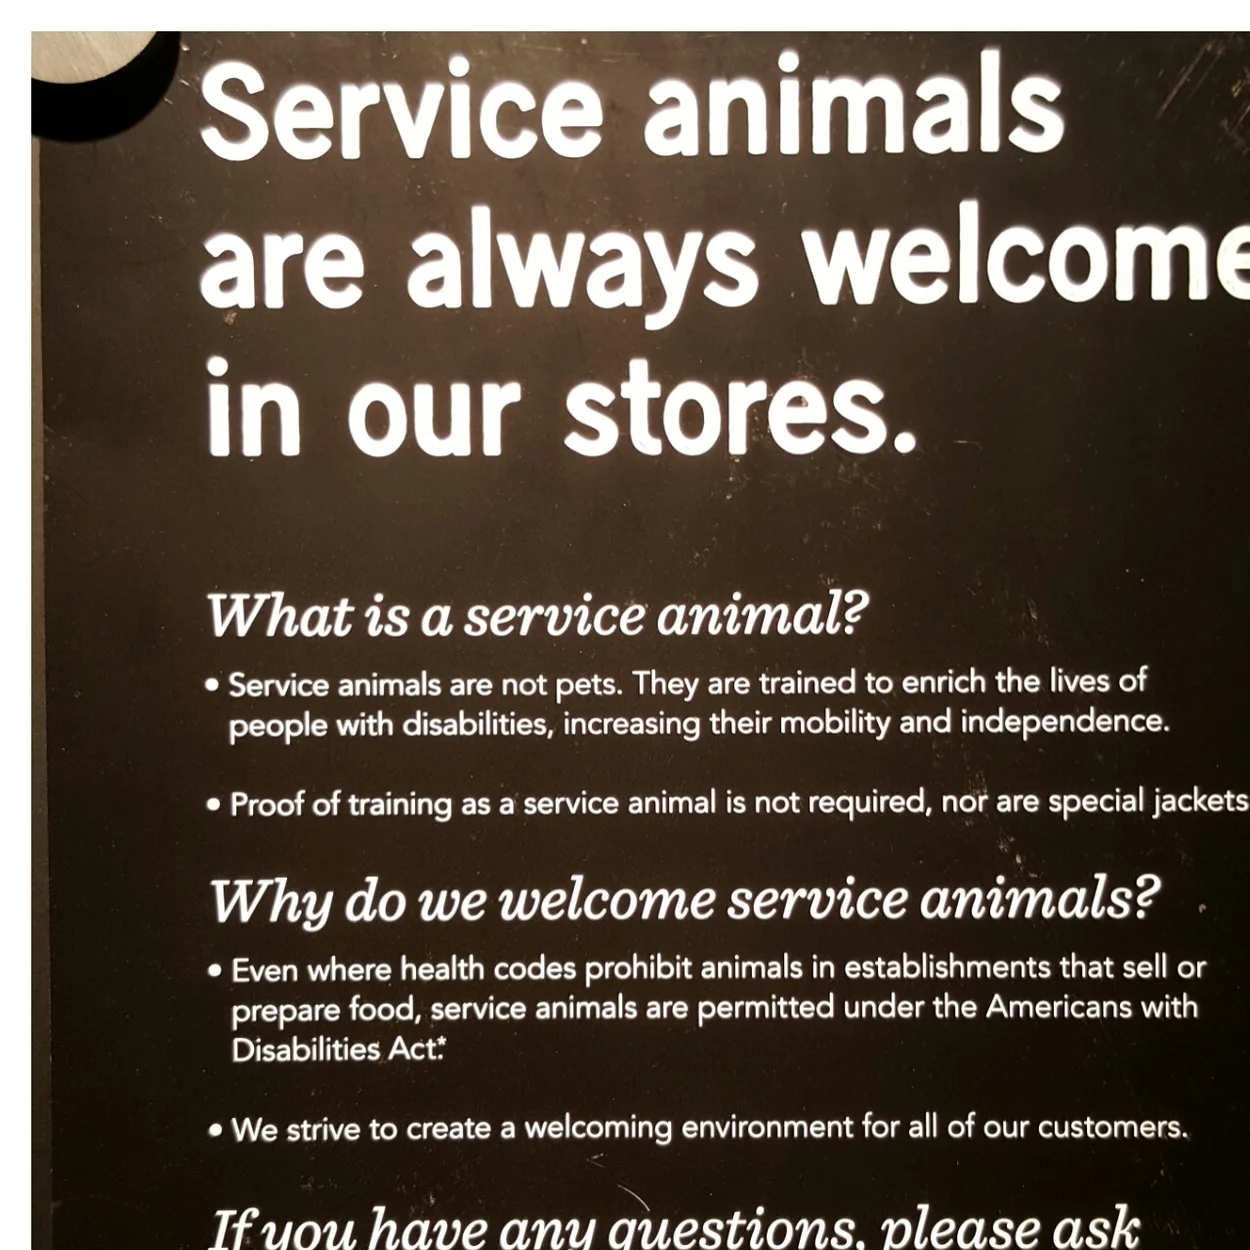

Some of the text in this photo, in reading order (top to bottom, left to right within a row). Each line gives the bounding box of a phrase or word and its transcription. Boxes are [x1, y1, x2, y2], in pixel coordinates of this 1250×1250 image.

[200, 47, 1065, 162] Service animals
[199, 231, 365, 310] are
[407, 203, 760, 331] always
[206, 355, 917, 458] in our stores.
[206, 588, 870, 638] What is a service animal?
[228, 664, 1149, 704] Service animals are not pets. They are trained to enrich the lives of
[229, 705, 1170, 746] people with disabilities, increasing their mobility and independence.
[231, 789, 306, 817] Proof
[312, 789, 342, 817] of
[347, 790, 452, 823] training
[461, 797, 491, 816] as
[499, 797, 515, 815] a
[523, 790, 620, 815] service
[628, 787, 716, 815] animal
[726, 789, 747, 814] is
[755, 791, 801, 814] not
[809, 786, 932, 822] required,
[942, 794, 989, 813] nor
[996, 794, 1040, 813] are
[1048, 785, 1144, 821] special
[210, 872, 1162, 933] Why do we welcome service animals?
[232, 952, 1207, 988] Even where health codes prohibit animals in establishments that sell or
[232, 992, 1198, 1031] prepare food, service animals are permitted under the Americans with
[233, 1035, 381, 1063] Disabilities
[231, 1111, 1188, 1146] We strive to create a welcoming environment for all of our customers.
[1053, 1203, 1141, 1250] ask
